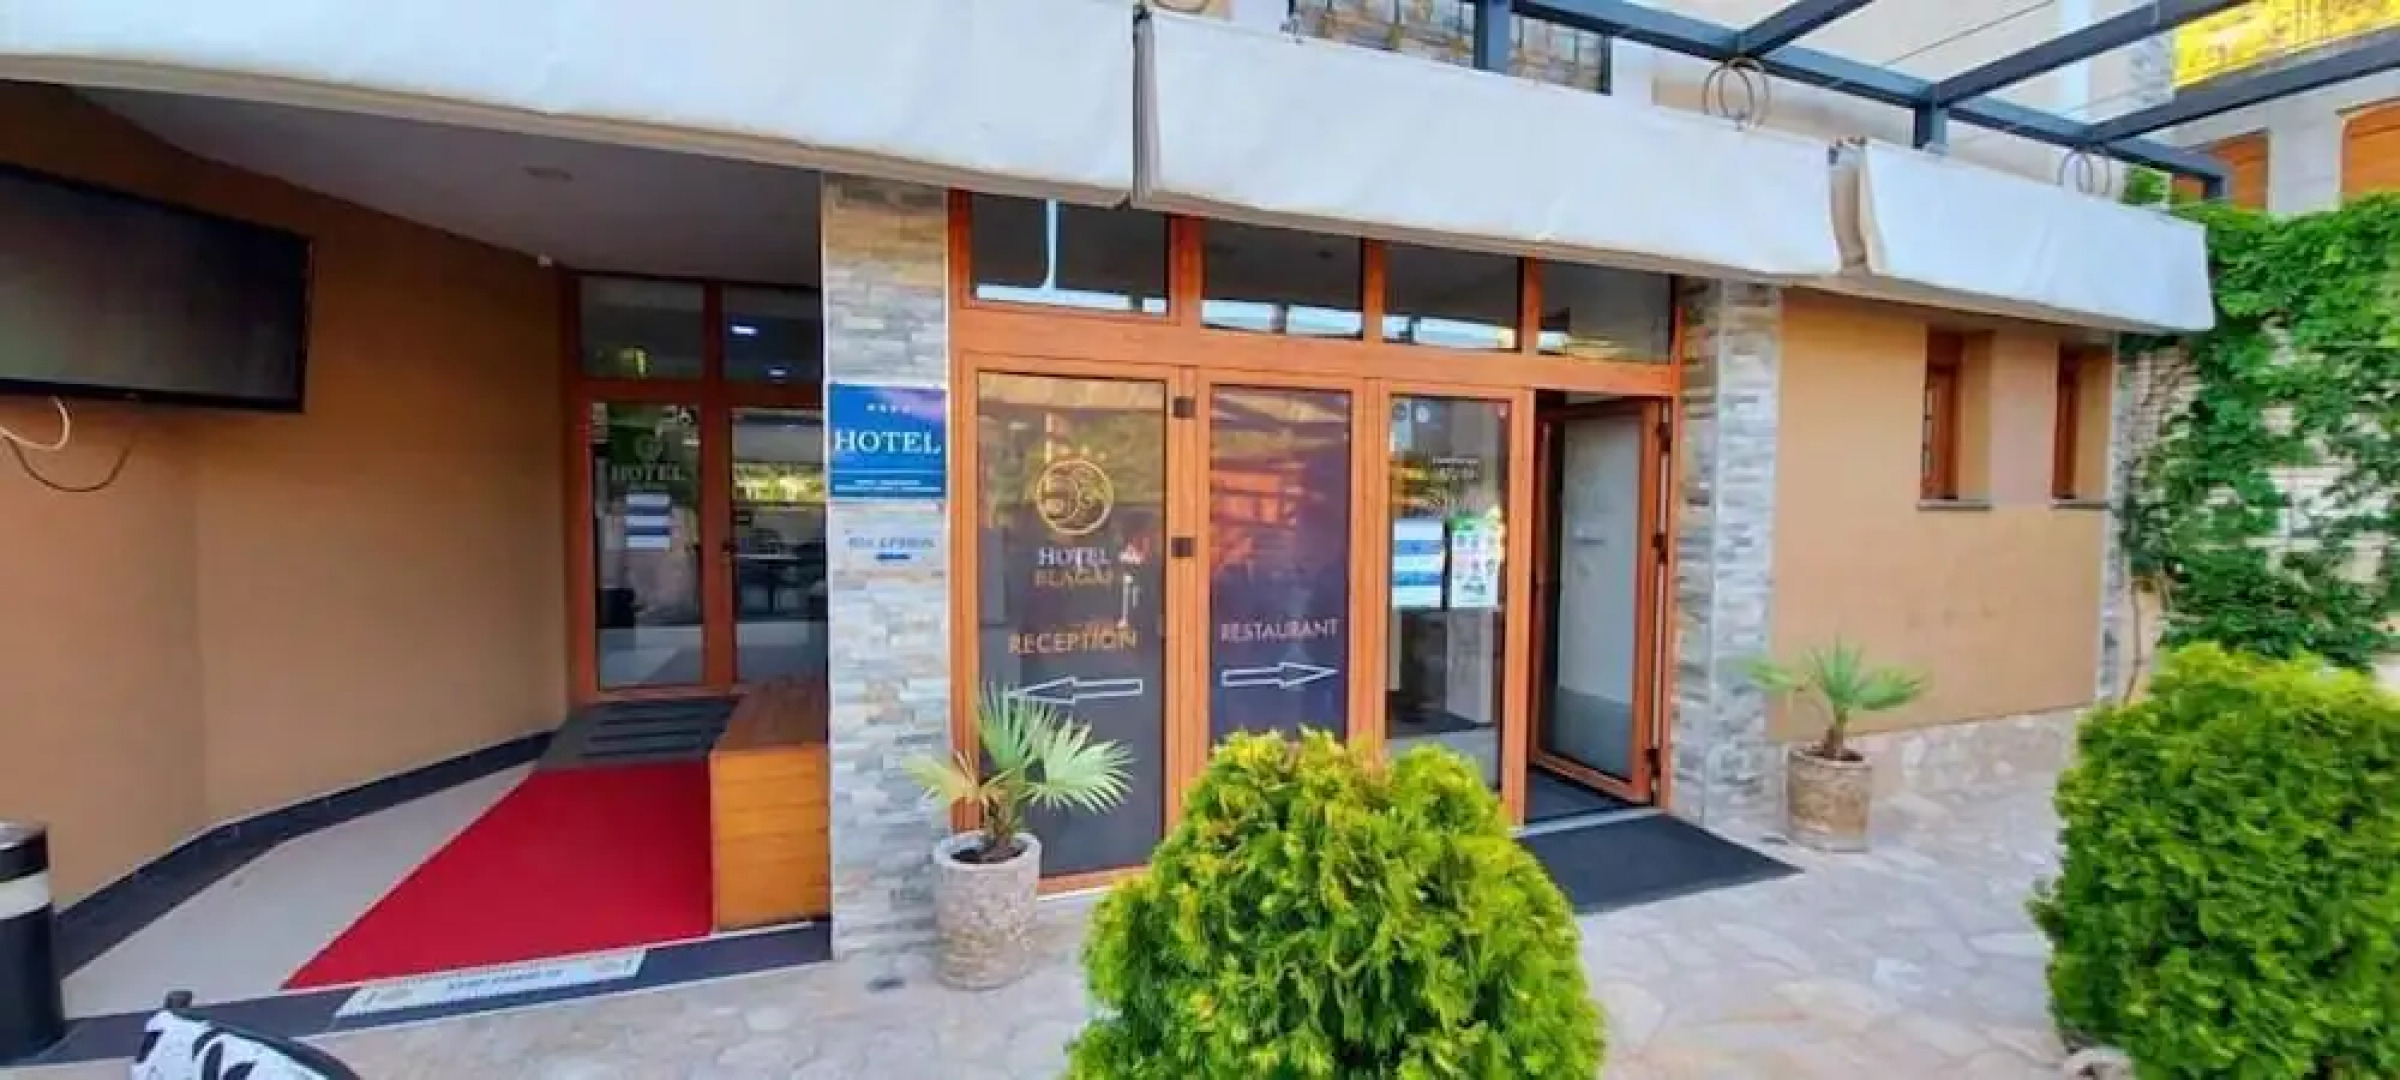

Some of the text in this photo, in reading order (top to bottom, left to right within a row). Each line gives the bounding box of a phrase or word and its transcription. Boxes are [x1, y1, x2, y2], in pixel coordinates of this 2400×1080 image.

[834, 429, 942, 455] HOTEL
[1038, 547, 1112, 566] HOTEL
[1008, 629, 1137, 654] RECEPTION
[1220, 618, 1339, 643] RESTAURANT
